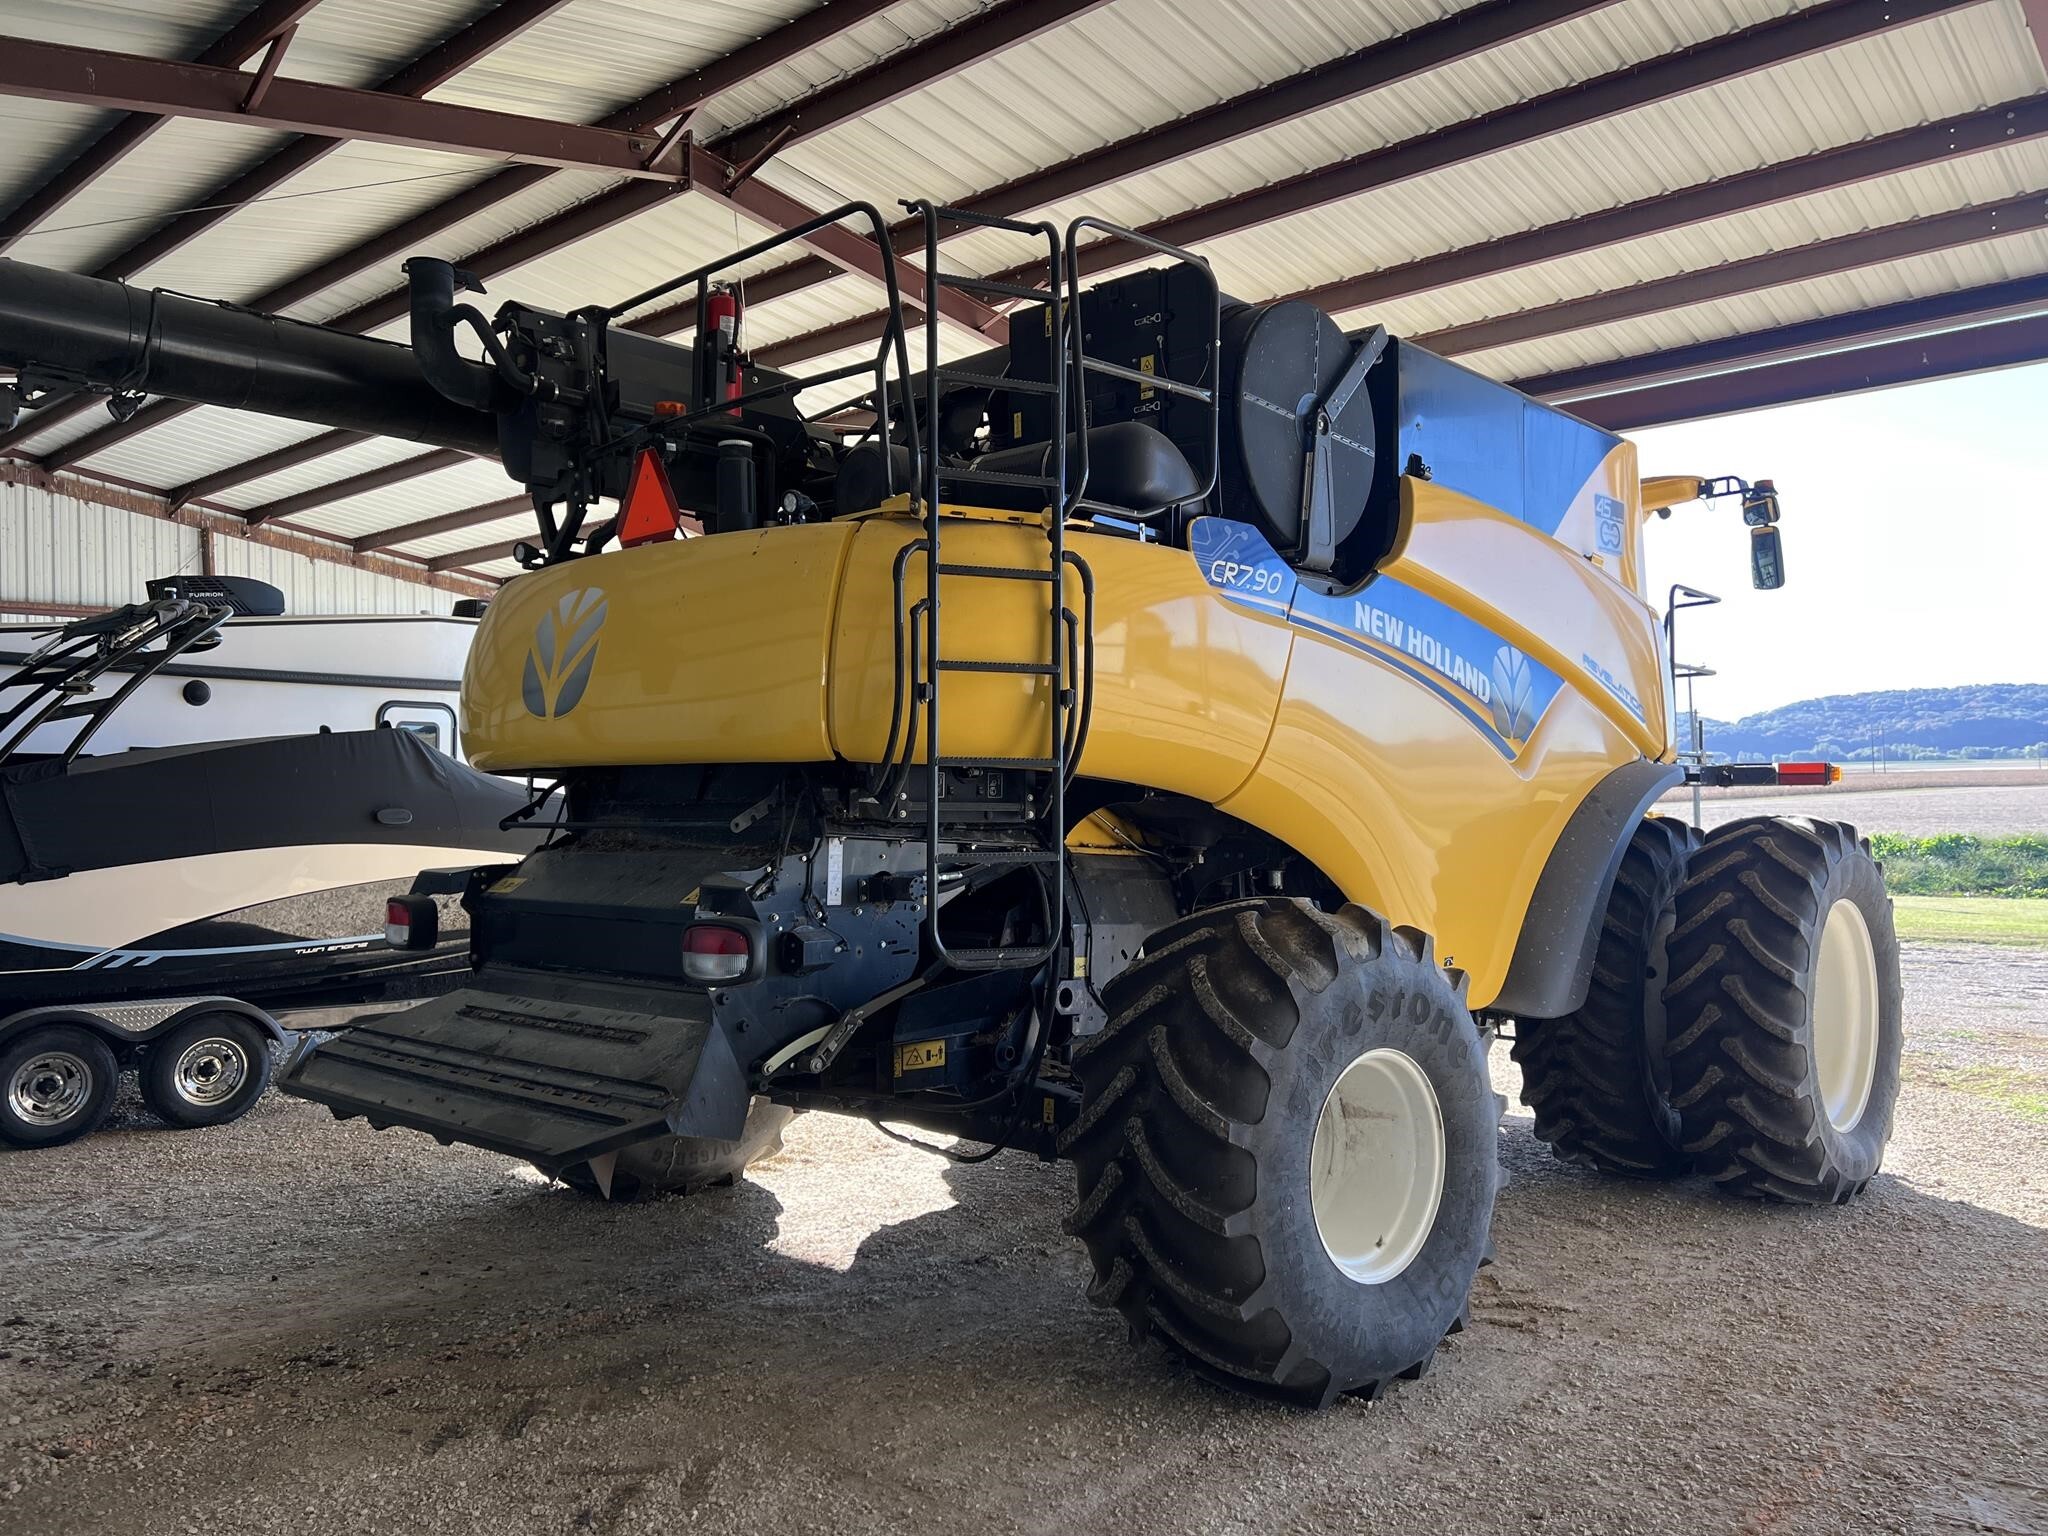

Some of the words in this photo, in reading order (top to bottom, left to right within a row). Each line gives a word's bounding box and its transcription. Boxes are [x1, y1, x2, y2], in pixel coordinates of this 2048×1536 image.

[1211, 560, 1282, 594] CR7.90
[1355, 600, 1404, 647] NEW
[1408, 625, 1490, 703] HOLLAND
[295, 947, 325, 955] TWIN
[327, 942, 369, 951] ENGINE
